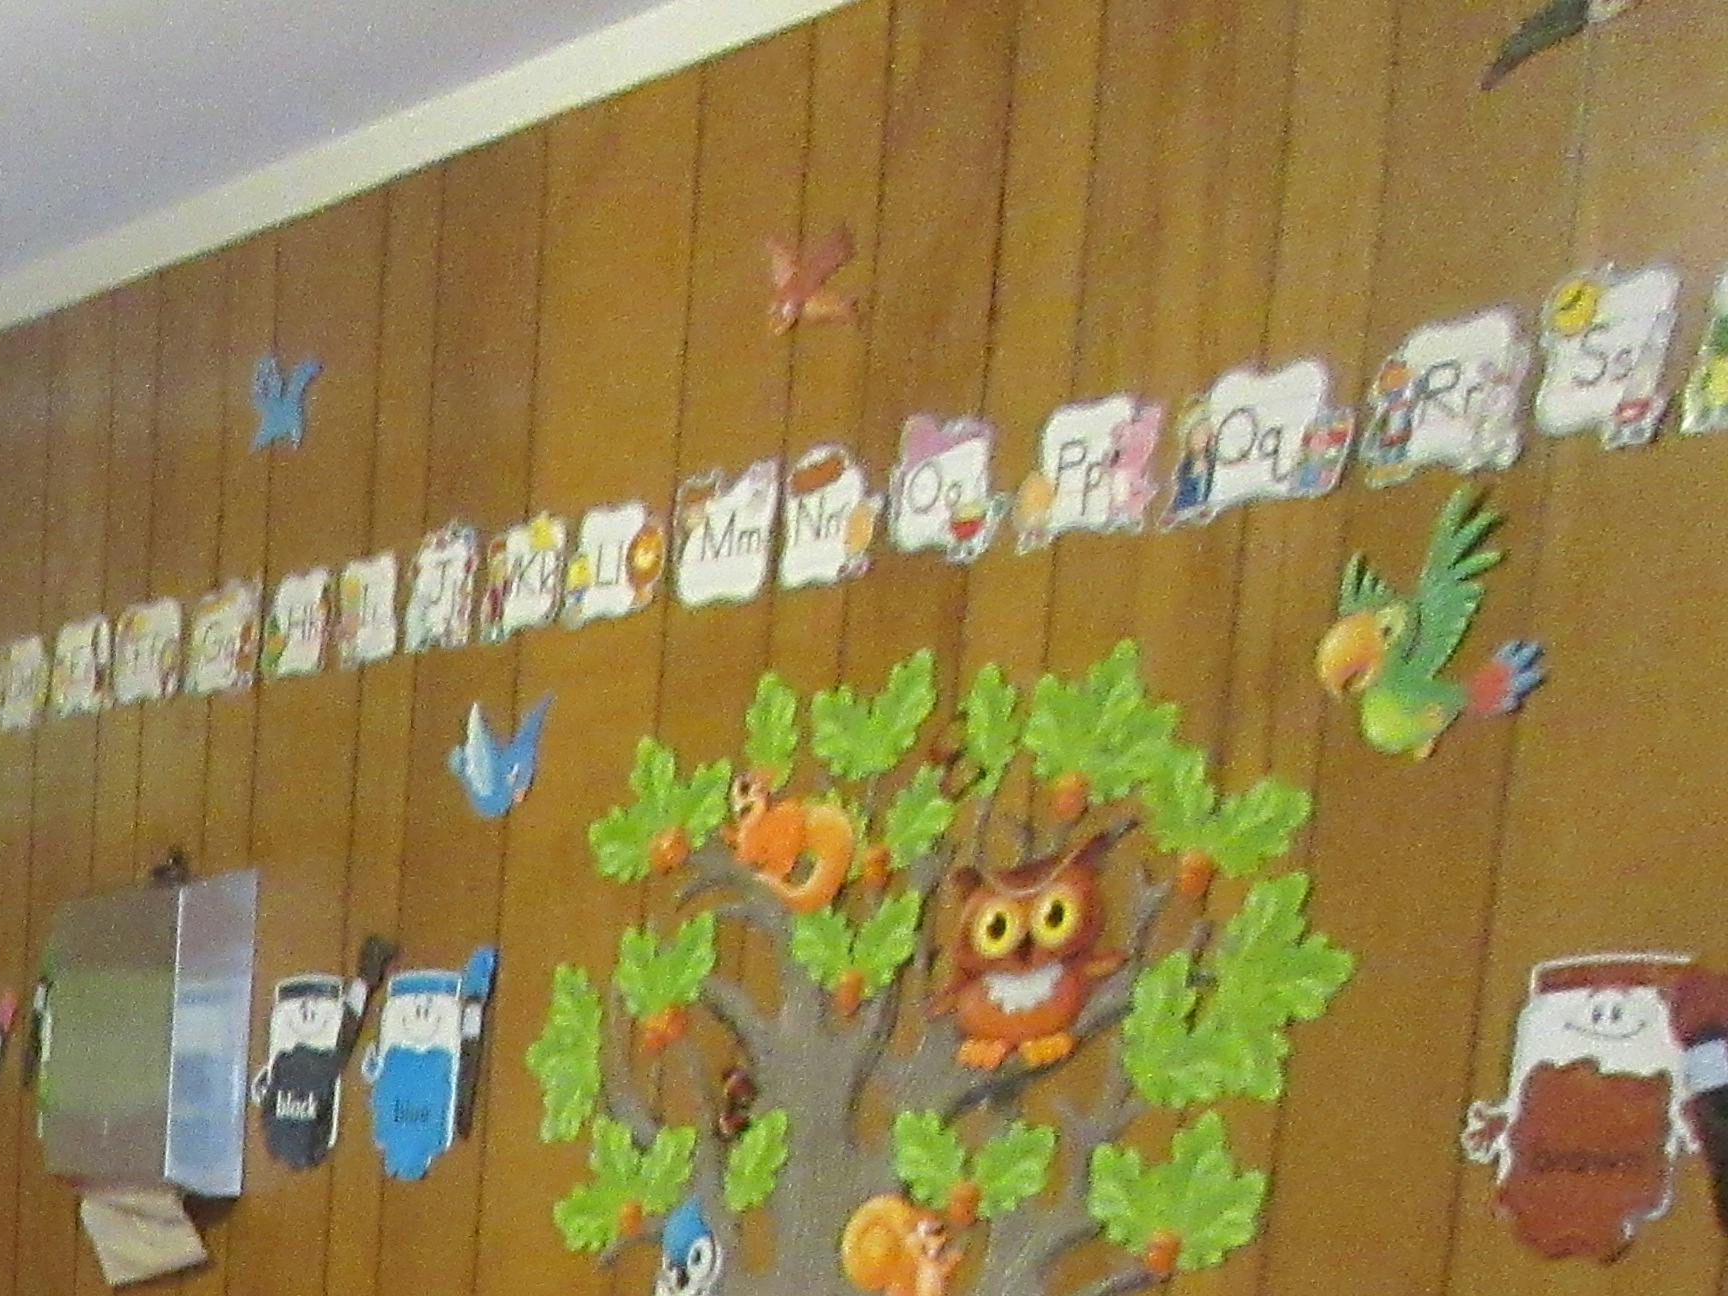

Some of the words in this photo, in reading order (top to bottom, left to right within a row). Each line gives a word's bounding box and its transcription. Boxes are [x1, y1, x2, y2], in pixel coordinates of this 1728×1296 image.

[700, 511, 761, 561] Mm
[797, 495, 842, 541] Nn
[908, 460, 962, 514] Oo
[1054, 439, 1103, 516] Pp
[1414, 359, 1482, 420] Rr
[1570, 325, 1633, 387] Ss
[275, 1089, 318, 1120] black
